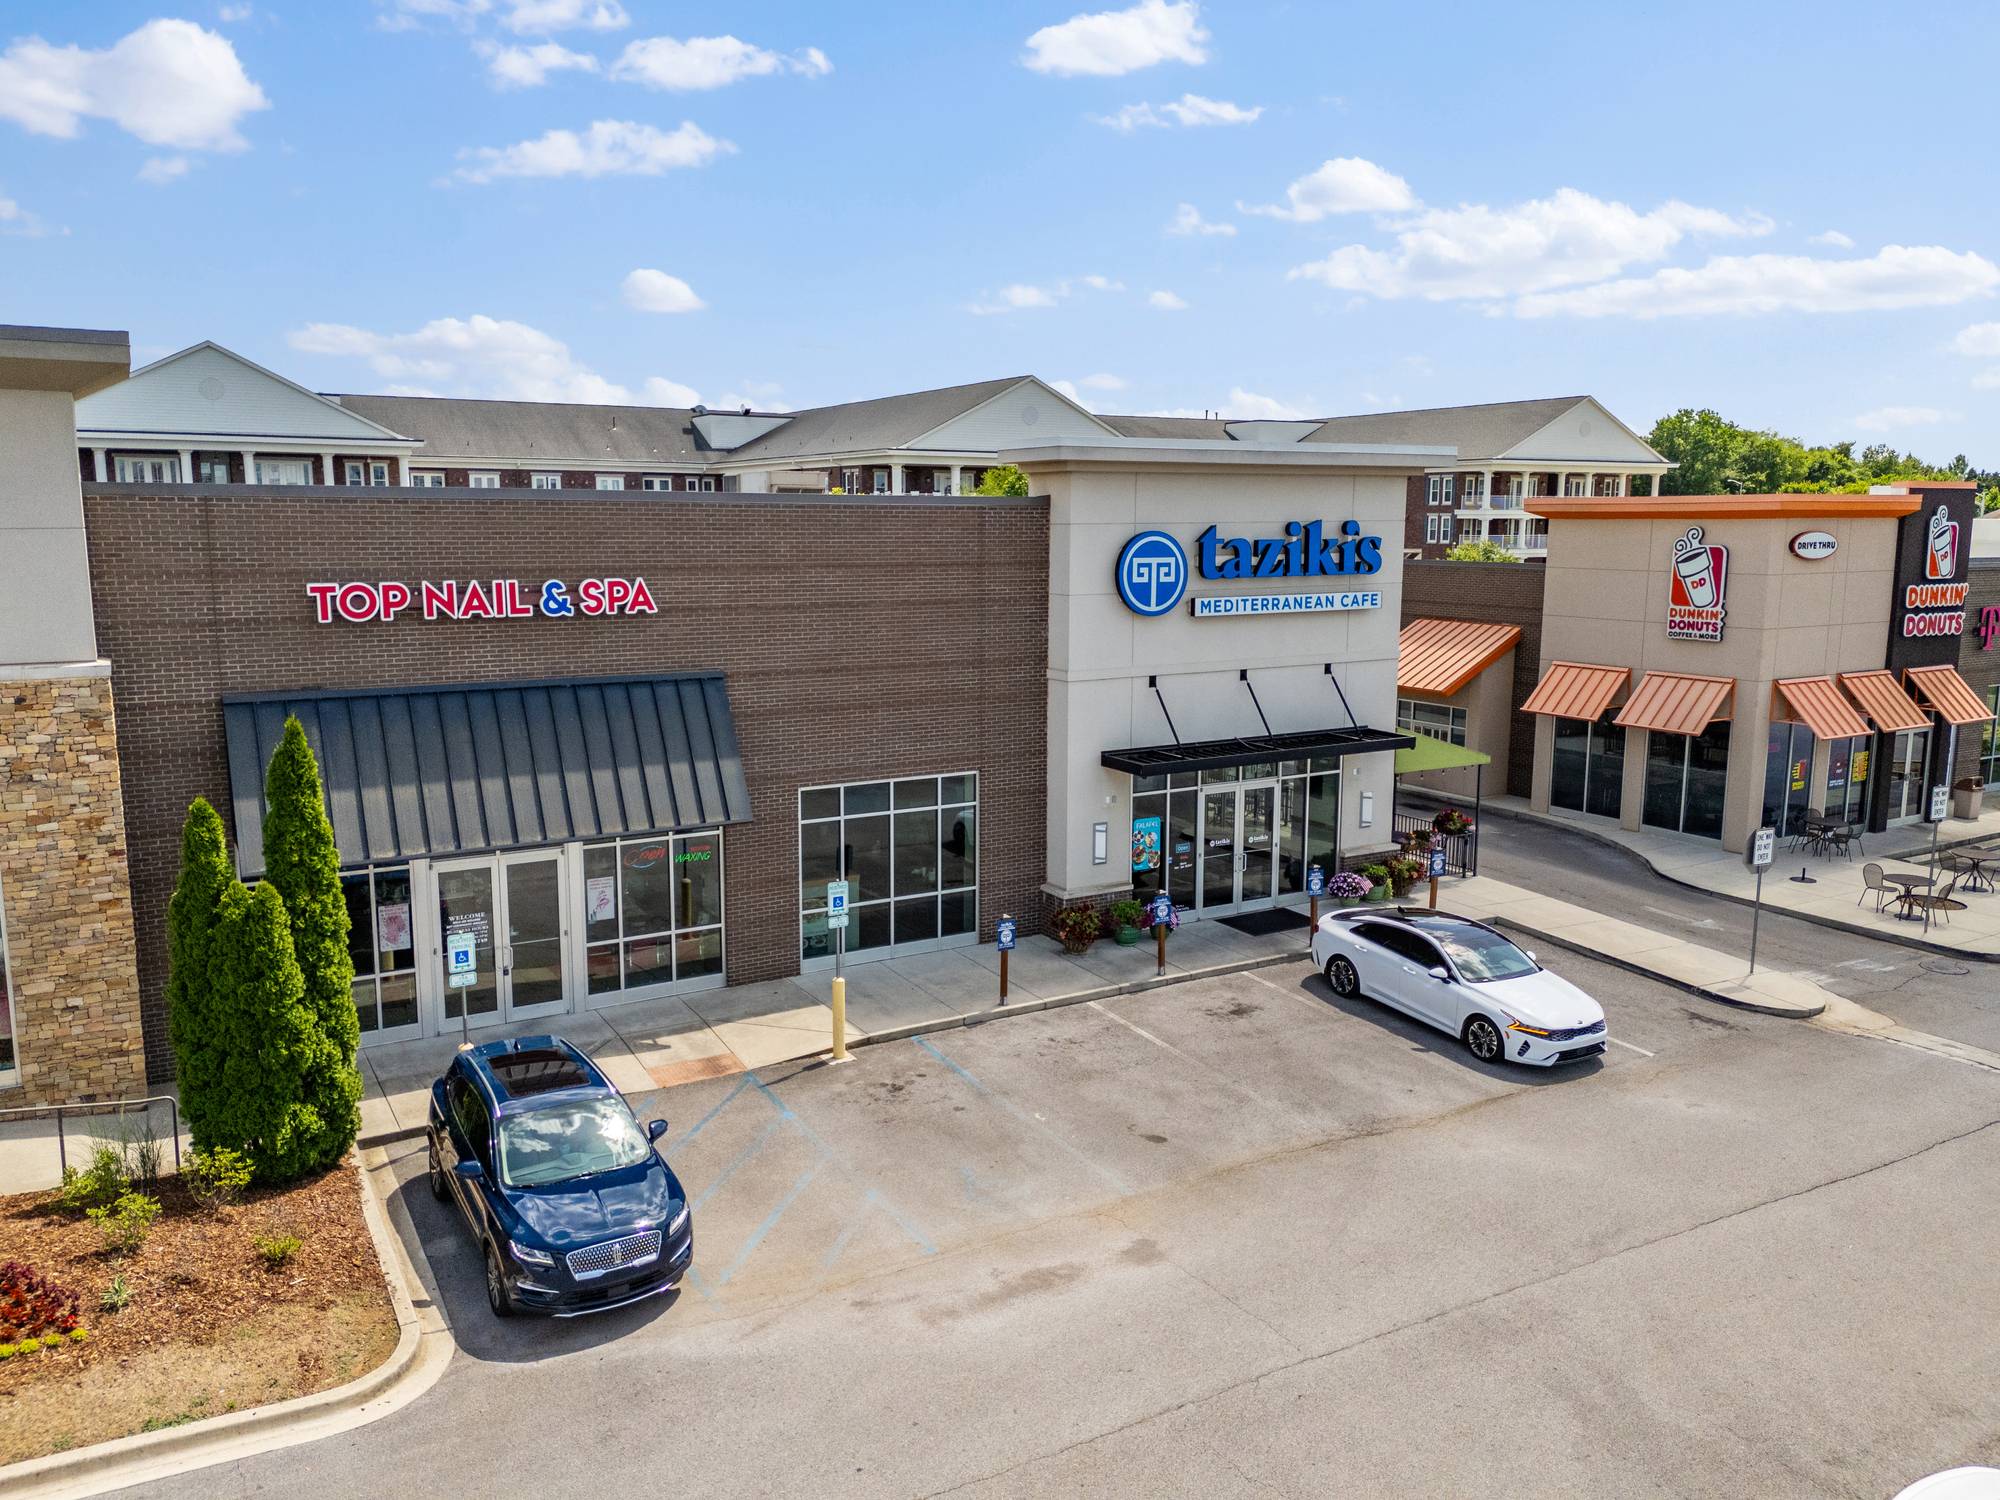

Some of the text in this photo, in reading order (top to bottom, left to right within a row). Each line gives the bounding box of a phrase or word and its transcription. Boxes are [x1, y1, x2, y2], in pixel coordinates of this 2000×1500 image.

[1195, 520, 1382, 580] tazikis
[1797, 541, 1836, 550] DRIVE THRU
[1690, 577, 1706, 589] DD
[307, 577, 658, 624] TOP NAIL & SPA
[1906, 582, 1969, 608] DUNKIN'
[1200, 593, 1379, 614] MEDITERRANEAN CAFE
[1669, 607, 1723, 621] DUNKIN'
[1668, 619, 1719, 633] DONUTS
[1904, 612, 1964, 637] DONUTS
[1668, 631, 1693, 639] COFFEE
[675, 850, 712, 863] WAXING
[448, 911, 486, 922] WELCOME
